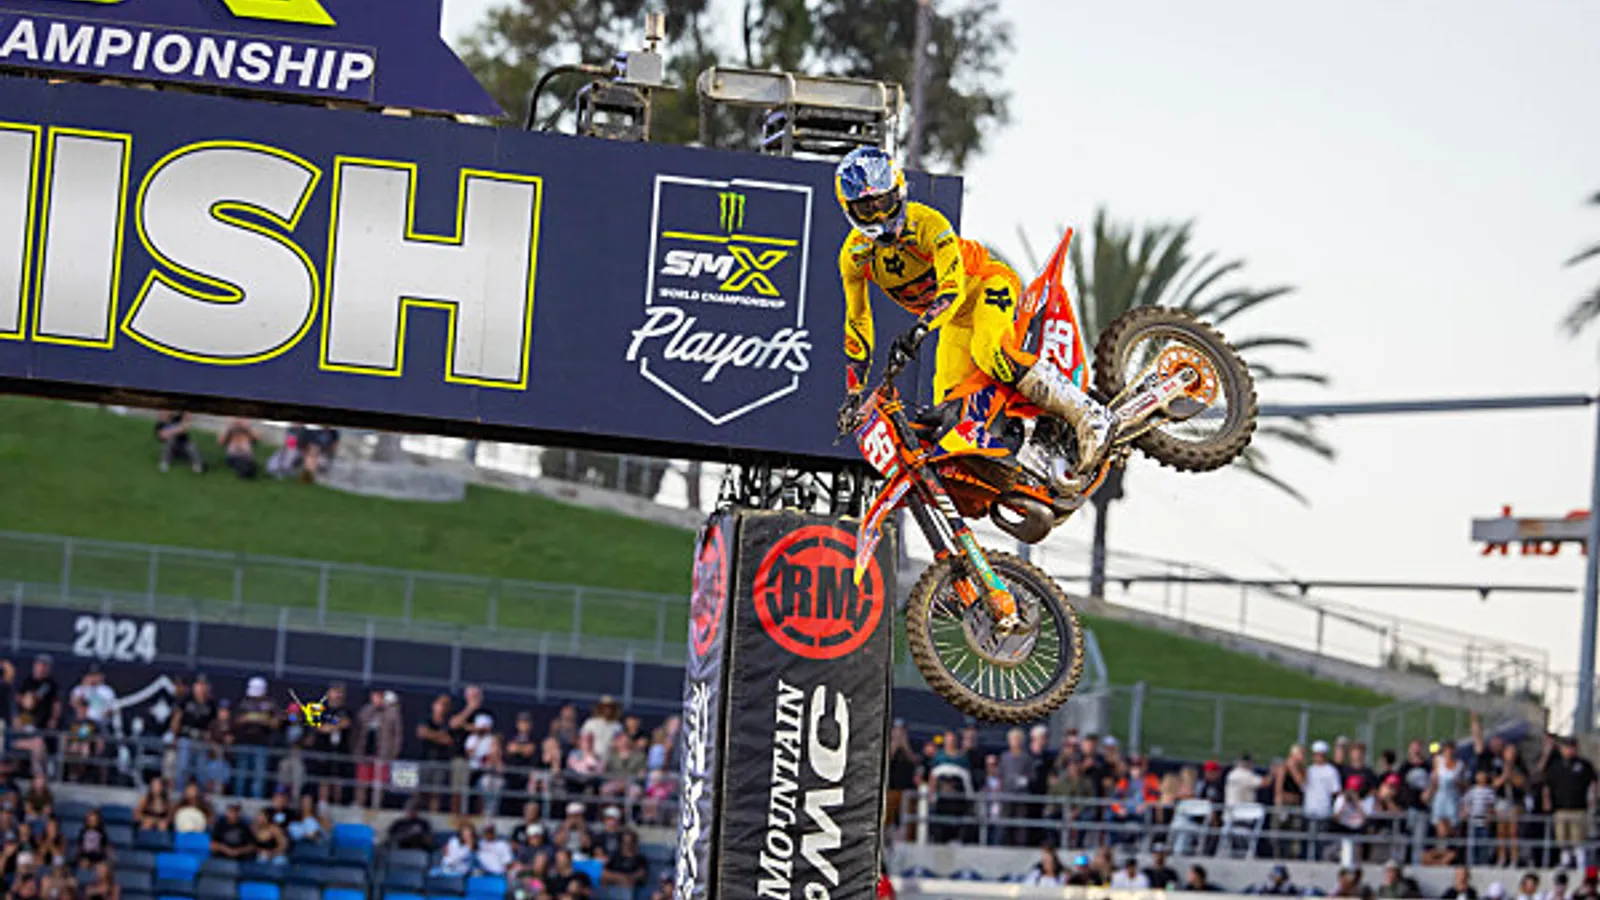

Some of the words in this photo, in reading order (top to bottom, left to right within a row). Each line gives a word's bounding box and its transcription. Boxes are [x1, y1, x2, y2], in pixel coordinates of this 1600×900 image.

[0, 18, 375, 92] AMPIONSHIP
[659, 287, 700, 299] WORLD
[701, 292, 786, 308] CHAMPIONSHIP
[660, 245, 789, 297] SMX
[626, 306, 813, 382] Playoffs
[862, 420, 897, 475] 26
[780, 563, 860, 622] RM
[73, 615, 157, 664] 2024
[757, 679, 805, 900] MOUNTAIN
